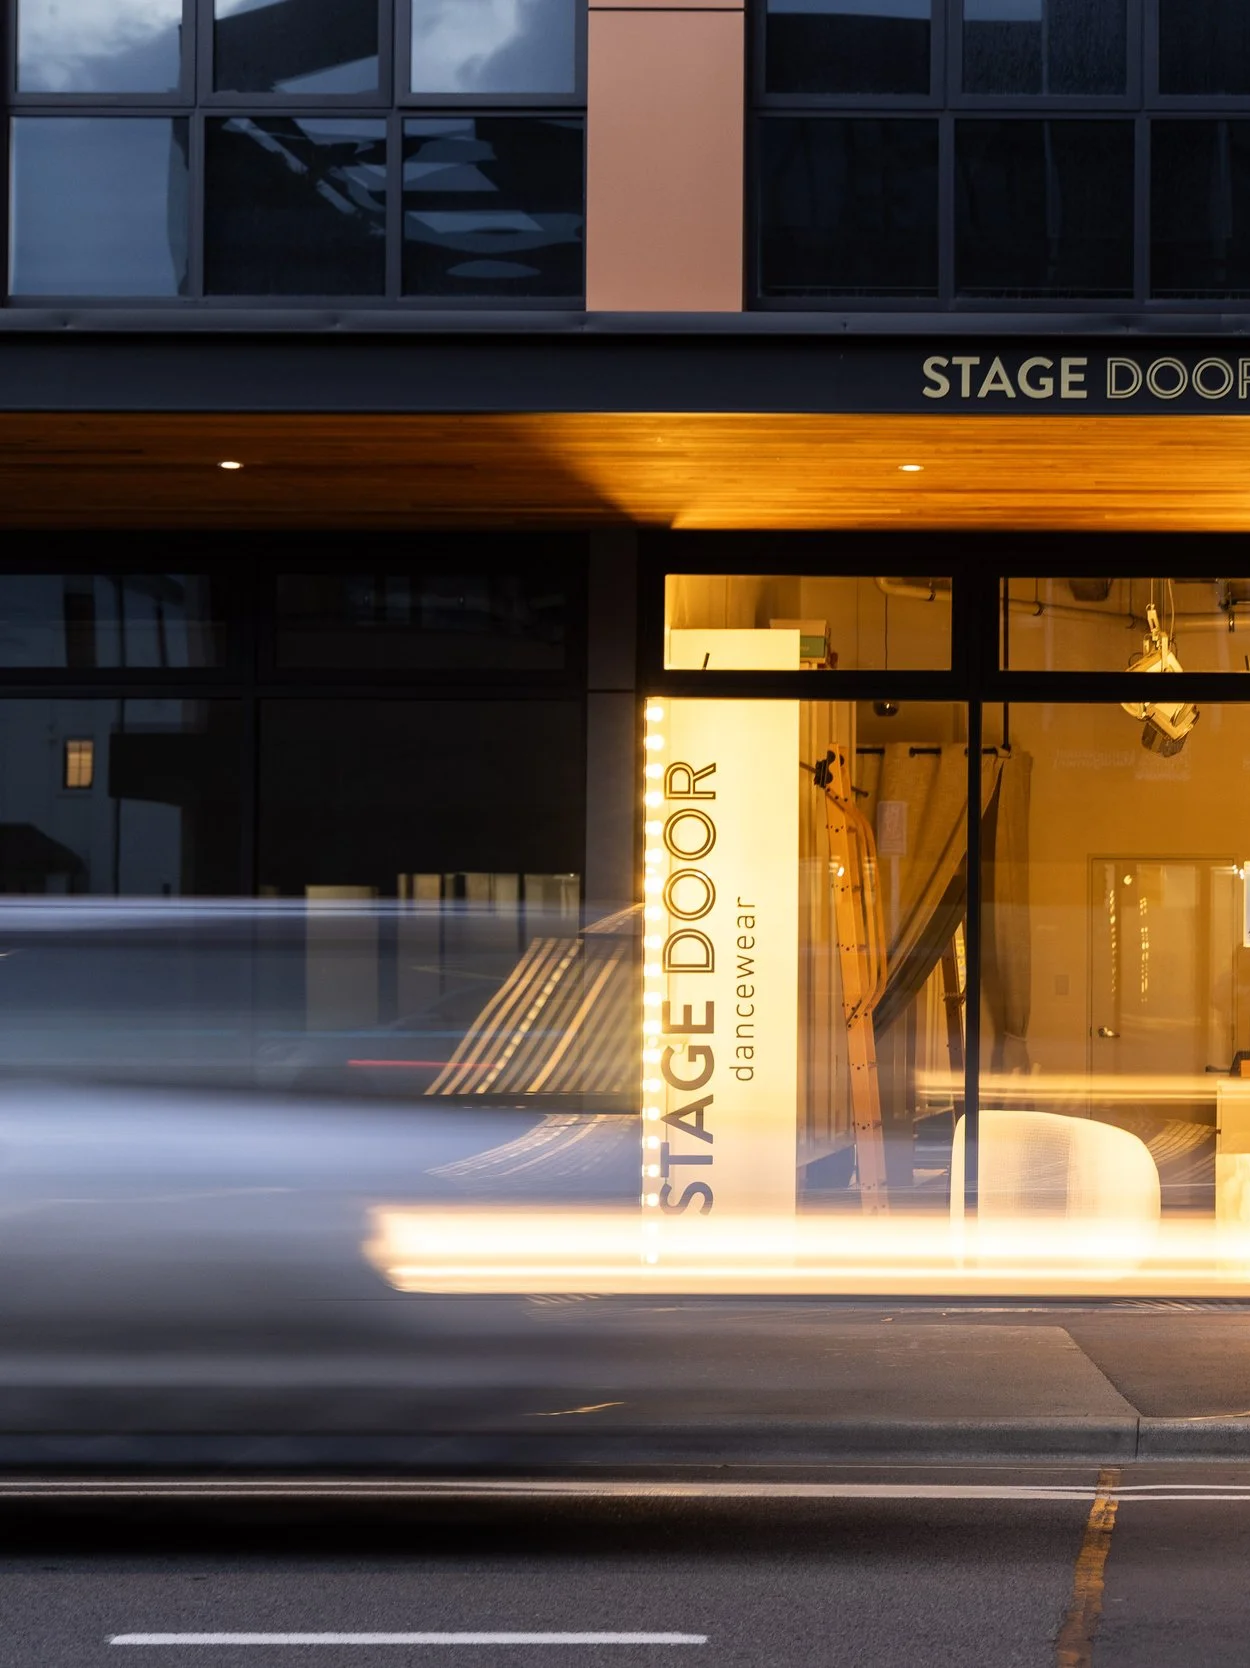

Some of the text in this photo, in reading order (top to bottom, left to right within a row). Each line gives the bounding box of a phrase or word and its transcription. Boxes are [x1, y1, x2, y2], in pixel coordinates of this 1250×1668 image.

[922, 356, 1088, 399] STAGE
[660, 762, 716, 1216] STAGE DOOR
[729, 897, 756, 1082] dancewear
